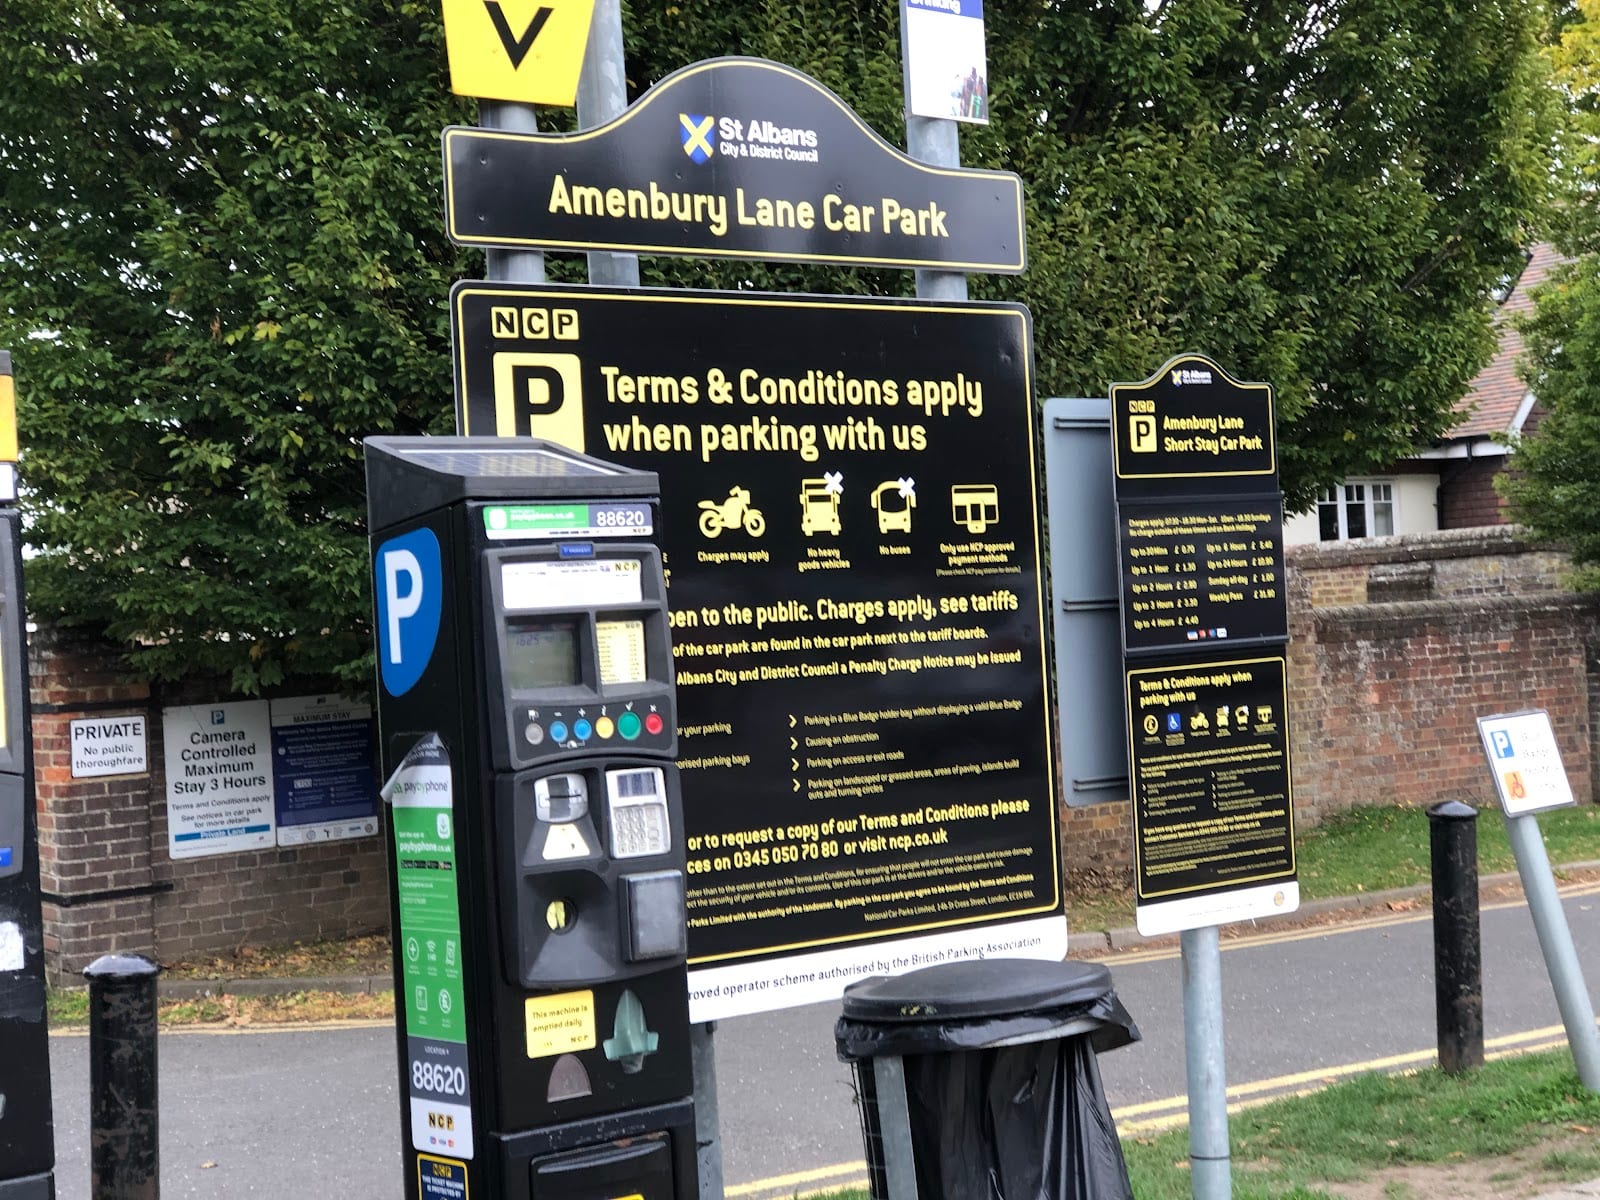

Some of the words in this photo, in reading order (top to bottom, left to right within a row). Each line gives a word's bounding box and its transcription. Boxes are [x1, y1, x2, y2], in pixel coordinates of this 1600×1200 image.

[719, 117, 744, 141] St
[747, 119, 818, 147] Albans
[720, 141, 739, 158] City
[740, 145, 748, 157] &
[749, 144, 783, 160] District
[784, 147, 819, 162] Council
[547, 174, 729, 238] Amenbury
[736, 188, 815, 231] Lane
[823, 193, 876, 234] Car
[882, 196, 950, 239] Park
[493, 308, 577, 338] NCP
[511, 364, 565, 437] P
[600, 366, 699, 404] Terms
[706, 367, 734, 405] &
[739, 367, 900, 406] Conditions
[906, 373, 983, 417] apply
[1135, 420, 1150, 447] P
[1163, 415, 1218, 434] Amenbury
[1218, 414, 1244, 430] Lane
[603, 415, 692, 451] when
[700, 416, 819, 462] parking
[822, 416, 886, 451] with
[892, 424, 927, 451] us
[1164, 436, 1194, 452] Short
[1194, 436, 1219, 455] Stay
[1220, 435, 1238, 451] Car
[1239, 435, 1263, 451] Park
[596, 511, 645, 527] 88620
[697, 550, 729, 564] Charges
[730, 552, 747, 564] may
[748, 549, 769, 563] apply
[807, 547, 818, 558] No
[818, 547, 840, 559] heavy
[879, 545, 889, 555] No
[890, 545, 911, 555] buses
[615, 562, 638, 571] NCP
[798, 560, 820, 572] goods
[820, 558, 851, 569] vehicles
[384, 549, 423, 664] P
[701, 607, 720, 626] to
[723, 603, 752, 625] the
[756, 600, 813, 630] public.
[816, 598, 884, 624] Charges
[888, 594, 937, 622] apply,
[940, 597, 968, 614] see
[971, 590, 1018, 613] tariffs
[672, 643, 685, 657] of
[685, 642, 704, 656] the
[705, 645, 723, 655] car
[725, 640, 750, 658] park
[751, 641, 769, 653] are
[770, 637, 800, 652] found
[801, 636, 812, 650] in
[813, 635, 831, 649] the
[832, 636, 849, 648] car
[850, 633, 873, 650] park
[874, 632, 897, 645] next
[898, 632, 909, 643] to
[909, 629, 926, 642] the
[927, 627, 952, 642] tariff
[953, 626, 988, 640] boards.
[676, 671, 713, 686] Albans
[715, 668, 737, 686] City
[738, 667, 759, 682] and
[760, 665, 800, 680] District
[800, 662, 838, 677] Council
[841, 663, 848, 674] a
[849, 660, 887, 676] Penalty
[888, 657, 922, 673] Charge
[923, 654, 954, 669] Notice
[955, 654, 976, 669] may
[977, 652, 989, 664] be
[990, 649, 1022, 664] issued
[1139, 679, 1162, 692] Terms
[1163, 678, 1170, 690] &
[1171, 675, 1210, 689] Conditions
[1211, 673, 1231, 687] apply
[1232, 671, 1252, 682] when
[1140, 693, 1169, 708] parking
[1170, 691, 1186, 702] with
[1186, 690, 1196, 701] us
[212, 710, 224, 724] P
[293, 712, 331, 723] MAXIMUM
[332, 711, 351, 720] STAY
[74, 722, 142, 741] PRIVATE
[190, 730, 246, 745] Camera
[83, 746, 98, 756] No
[102, 744, 134, 756] public
[181, 743, 256, 761] Controlled
[76, 757, 143, 769] thoroughfare
[185, 761, 254, 777] Maximum
[174, 781, 206, 795] Stay
[210, 778, 219, 791] 3
[223, 775, 267, 789] Hours
[404, 781, 448, 795] paybyphone
[172, 803, 194, 811] Terms
[211, 797, 250, 807] Conditions
[252, 794, 271, 803] apply
[196, 812, 223, 820] notices
[246, 807, 262, 816] park
[226, 817, 250, 826] details
[688, 837, 702, 850] or
[704, 834, 719, 849] to
[722, 827, 774, 849] request
[776, 829, 785, 841] a
[787, 823, 819, 842] copy
[821, 818, 835, 835] of
[836, 818, 858, 834] our
[859, 814, 898, 831] Terms
[900, 808, 924, 827] and
[925, 803, 989, 824] Conditions
[991, 799, 1030, 820] please
[687, 859, 711, 874] ces
[714, 857, 731, 871] on
[734, 848, 769, 869] 0345
[772, 845, 799, 864] 050
[801, 842, 819, 860] 70
[821, 840, 838, 858] 80
[843, 841, 857, 855] or
[859, 835, 887, 853] visit
[889, 827, 948, 852] ncp.co.uk
[688, 985, 720, 1001] roved
[723, 979, 771, 998] operator
[773, 971, 815, 987] scheme
[818, 962, 874, 980] authorised
[877, 960, 890, 974] by
[892, 956, 909, 968] the
[911, 950, 945, 965] British
[947, 947, 985, 960] Parking
[986, 937, 1041, 953] Association
[549, 1006, 580, 1016] machine
[533, 1020, 562, 1032] emptied
[564, 1018, 583, 1028] daily
[412, 1060, 466, 1096] 88620
[428, 1112, 455, 1131] NCP
